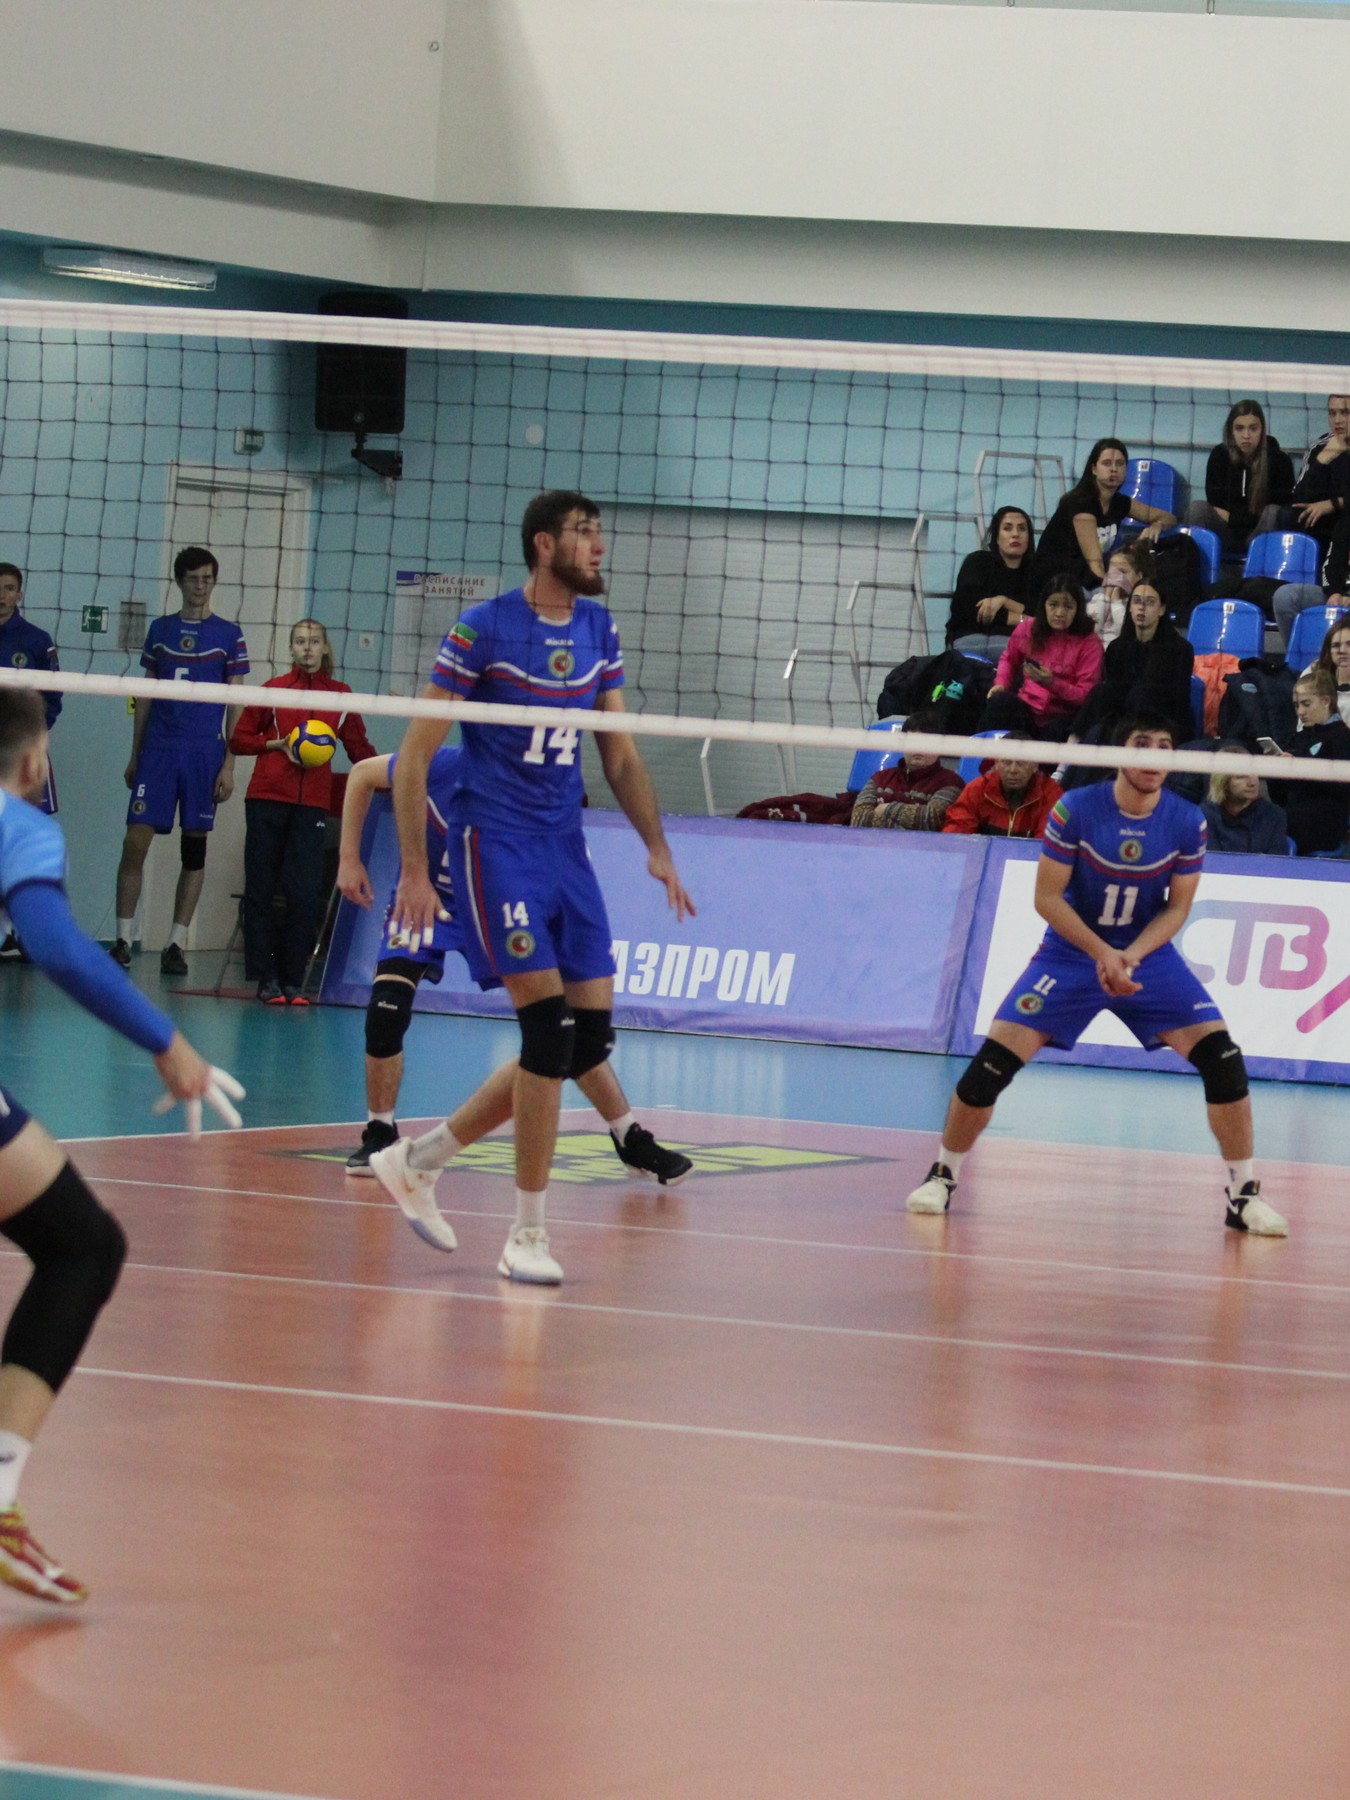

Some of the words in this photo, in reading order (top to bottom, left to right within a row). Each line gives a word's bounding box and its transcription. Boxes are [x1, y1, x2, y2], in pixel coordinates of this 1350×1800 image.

[523, 724, 579, 765] 14
[137, 783, 146, 798] 6
[502, 901, 529, 928] 14
[1097, 883, 1139, 926] 11
[610, 939, 796, 1006] АЗПРОМ
[1033, 974, 1057, 996] 11
